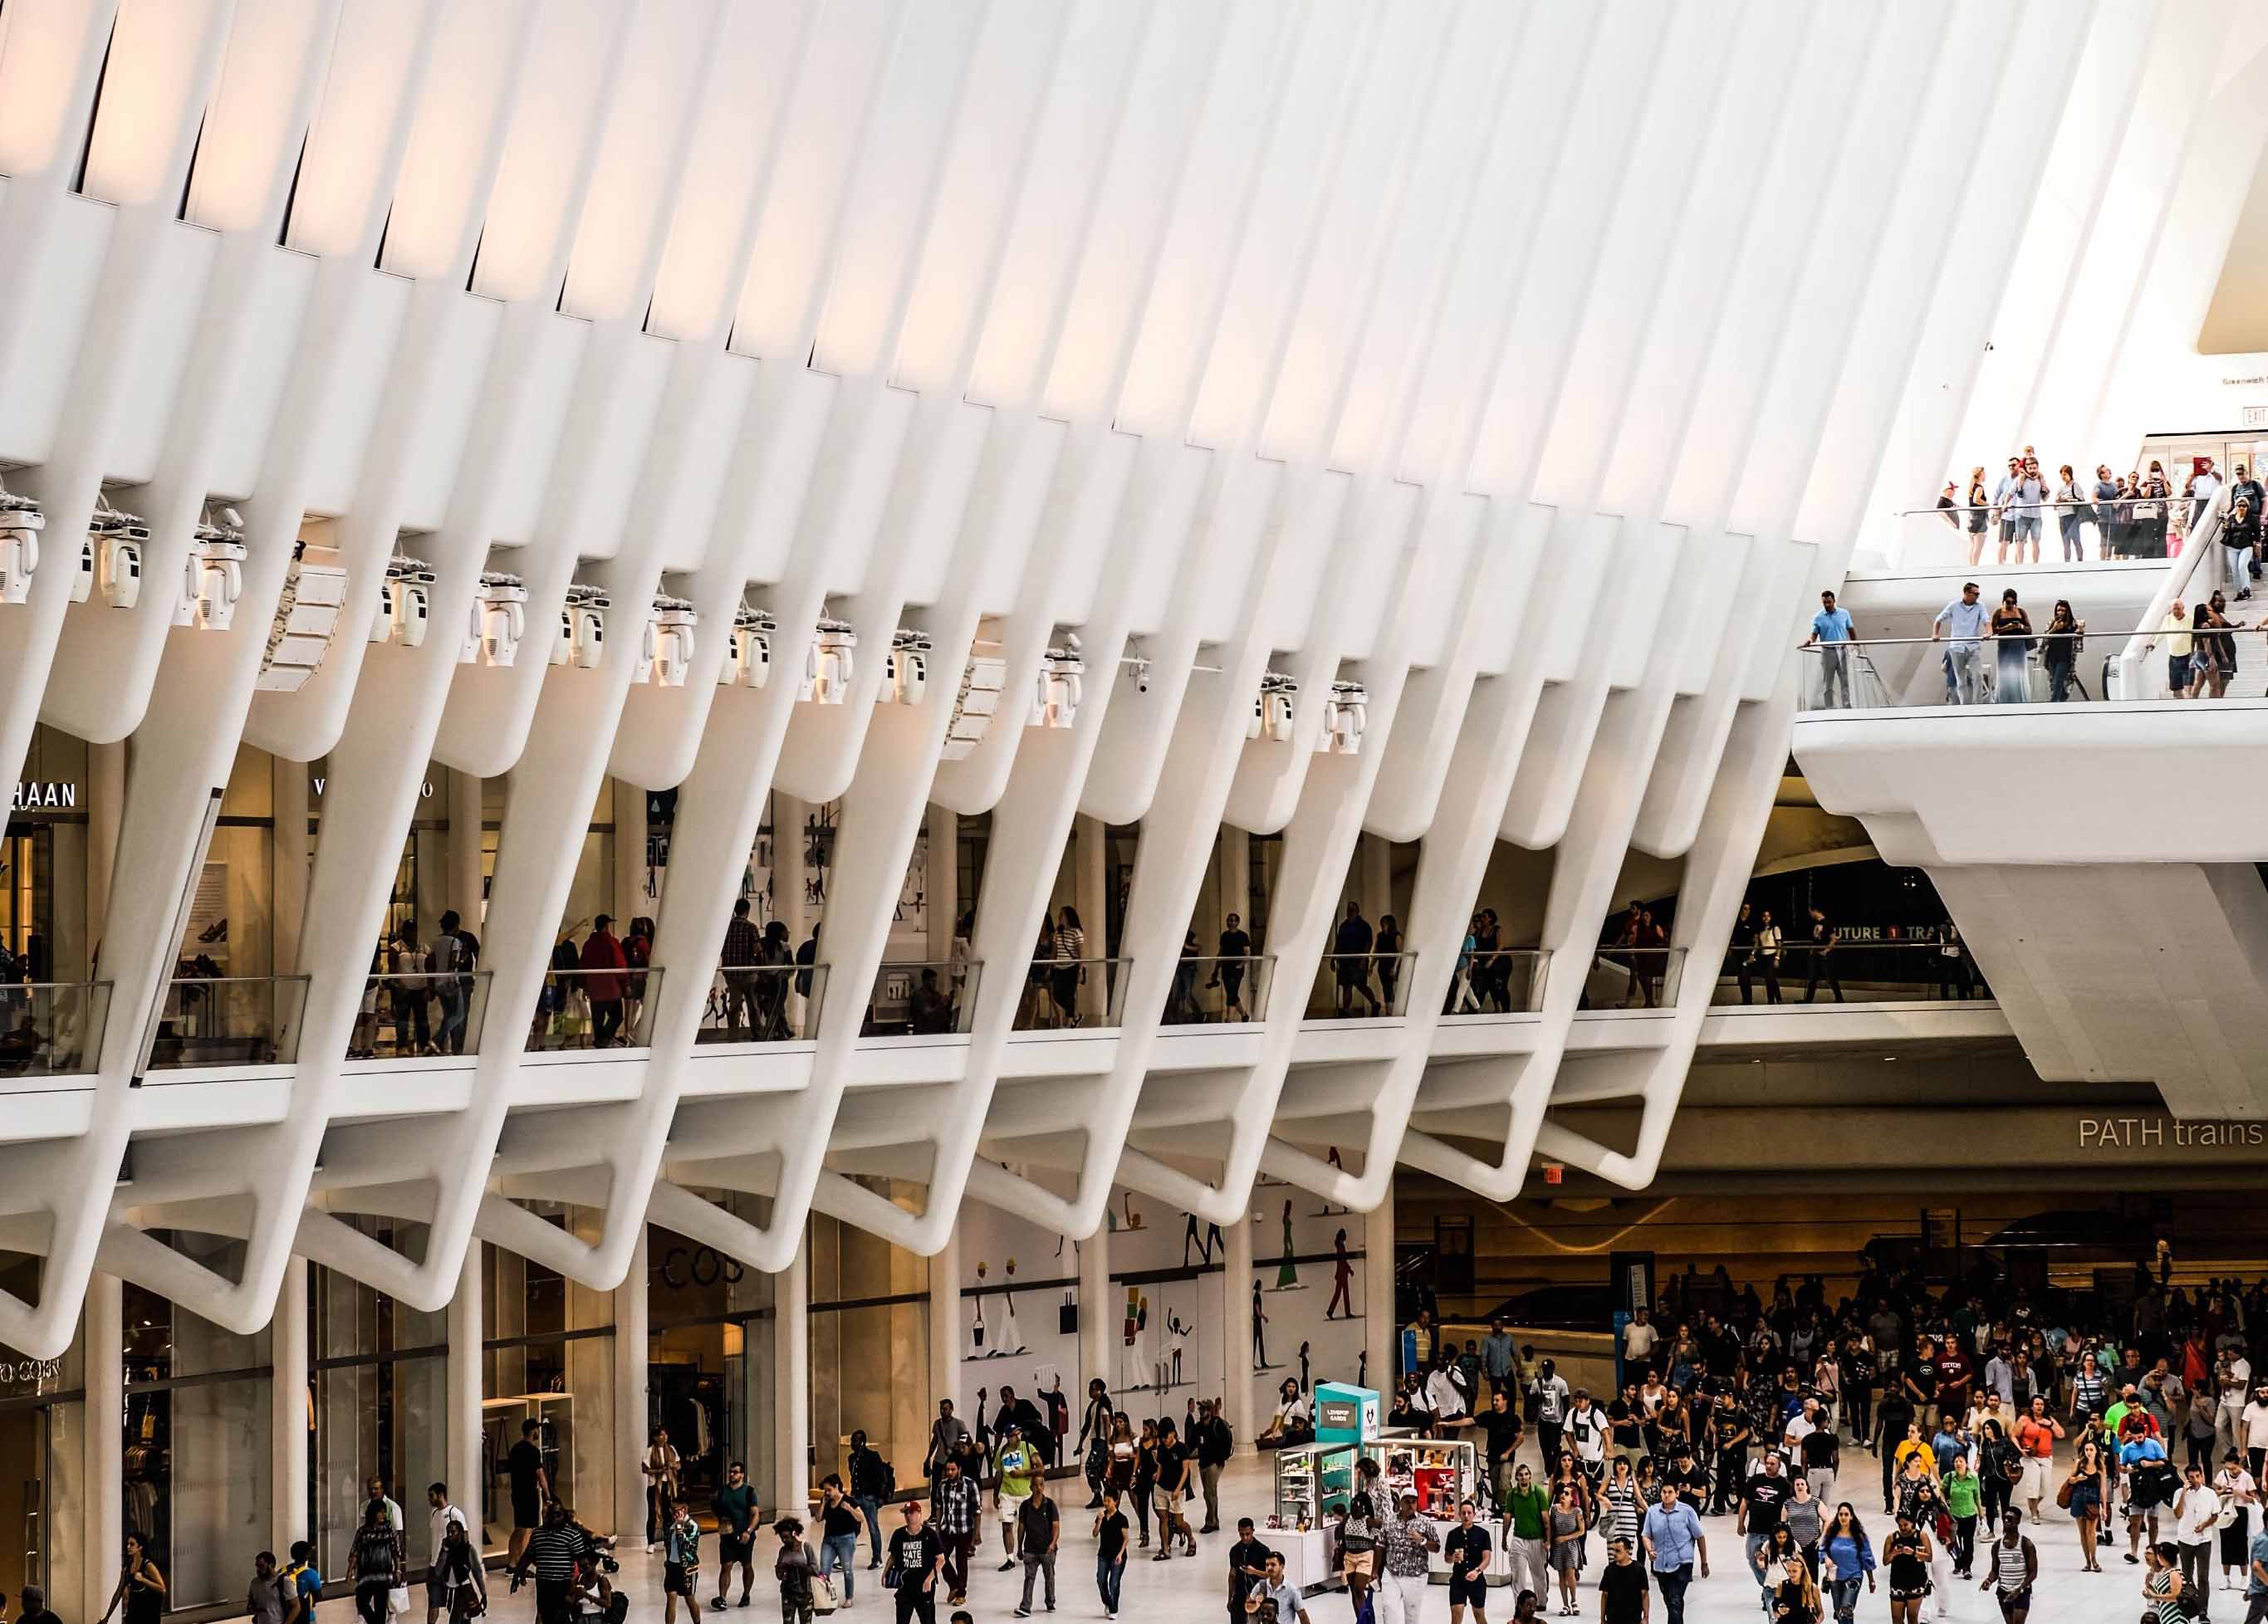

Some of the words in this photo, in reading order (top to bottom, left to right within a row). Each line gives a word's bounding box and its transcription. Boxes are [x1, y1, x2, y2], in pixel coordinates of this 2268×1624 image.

[1834, 926, 1881, 939] UTURE
[1907, 926, 1936, 940] TRA
[2079, 1118, 2163, 1147] PATH
[2172, 1119, 2263, 1146] trains
[909, 1558, 923, 1568] LOSE
